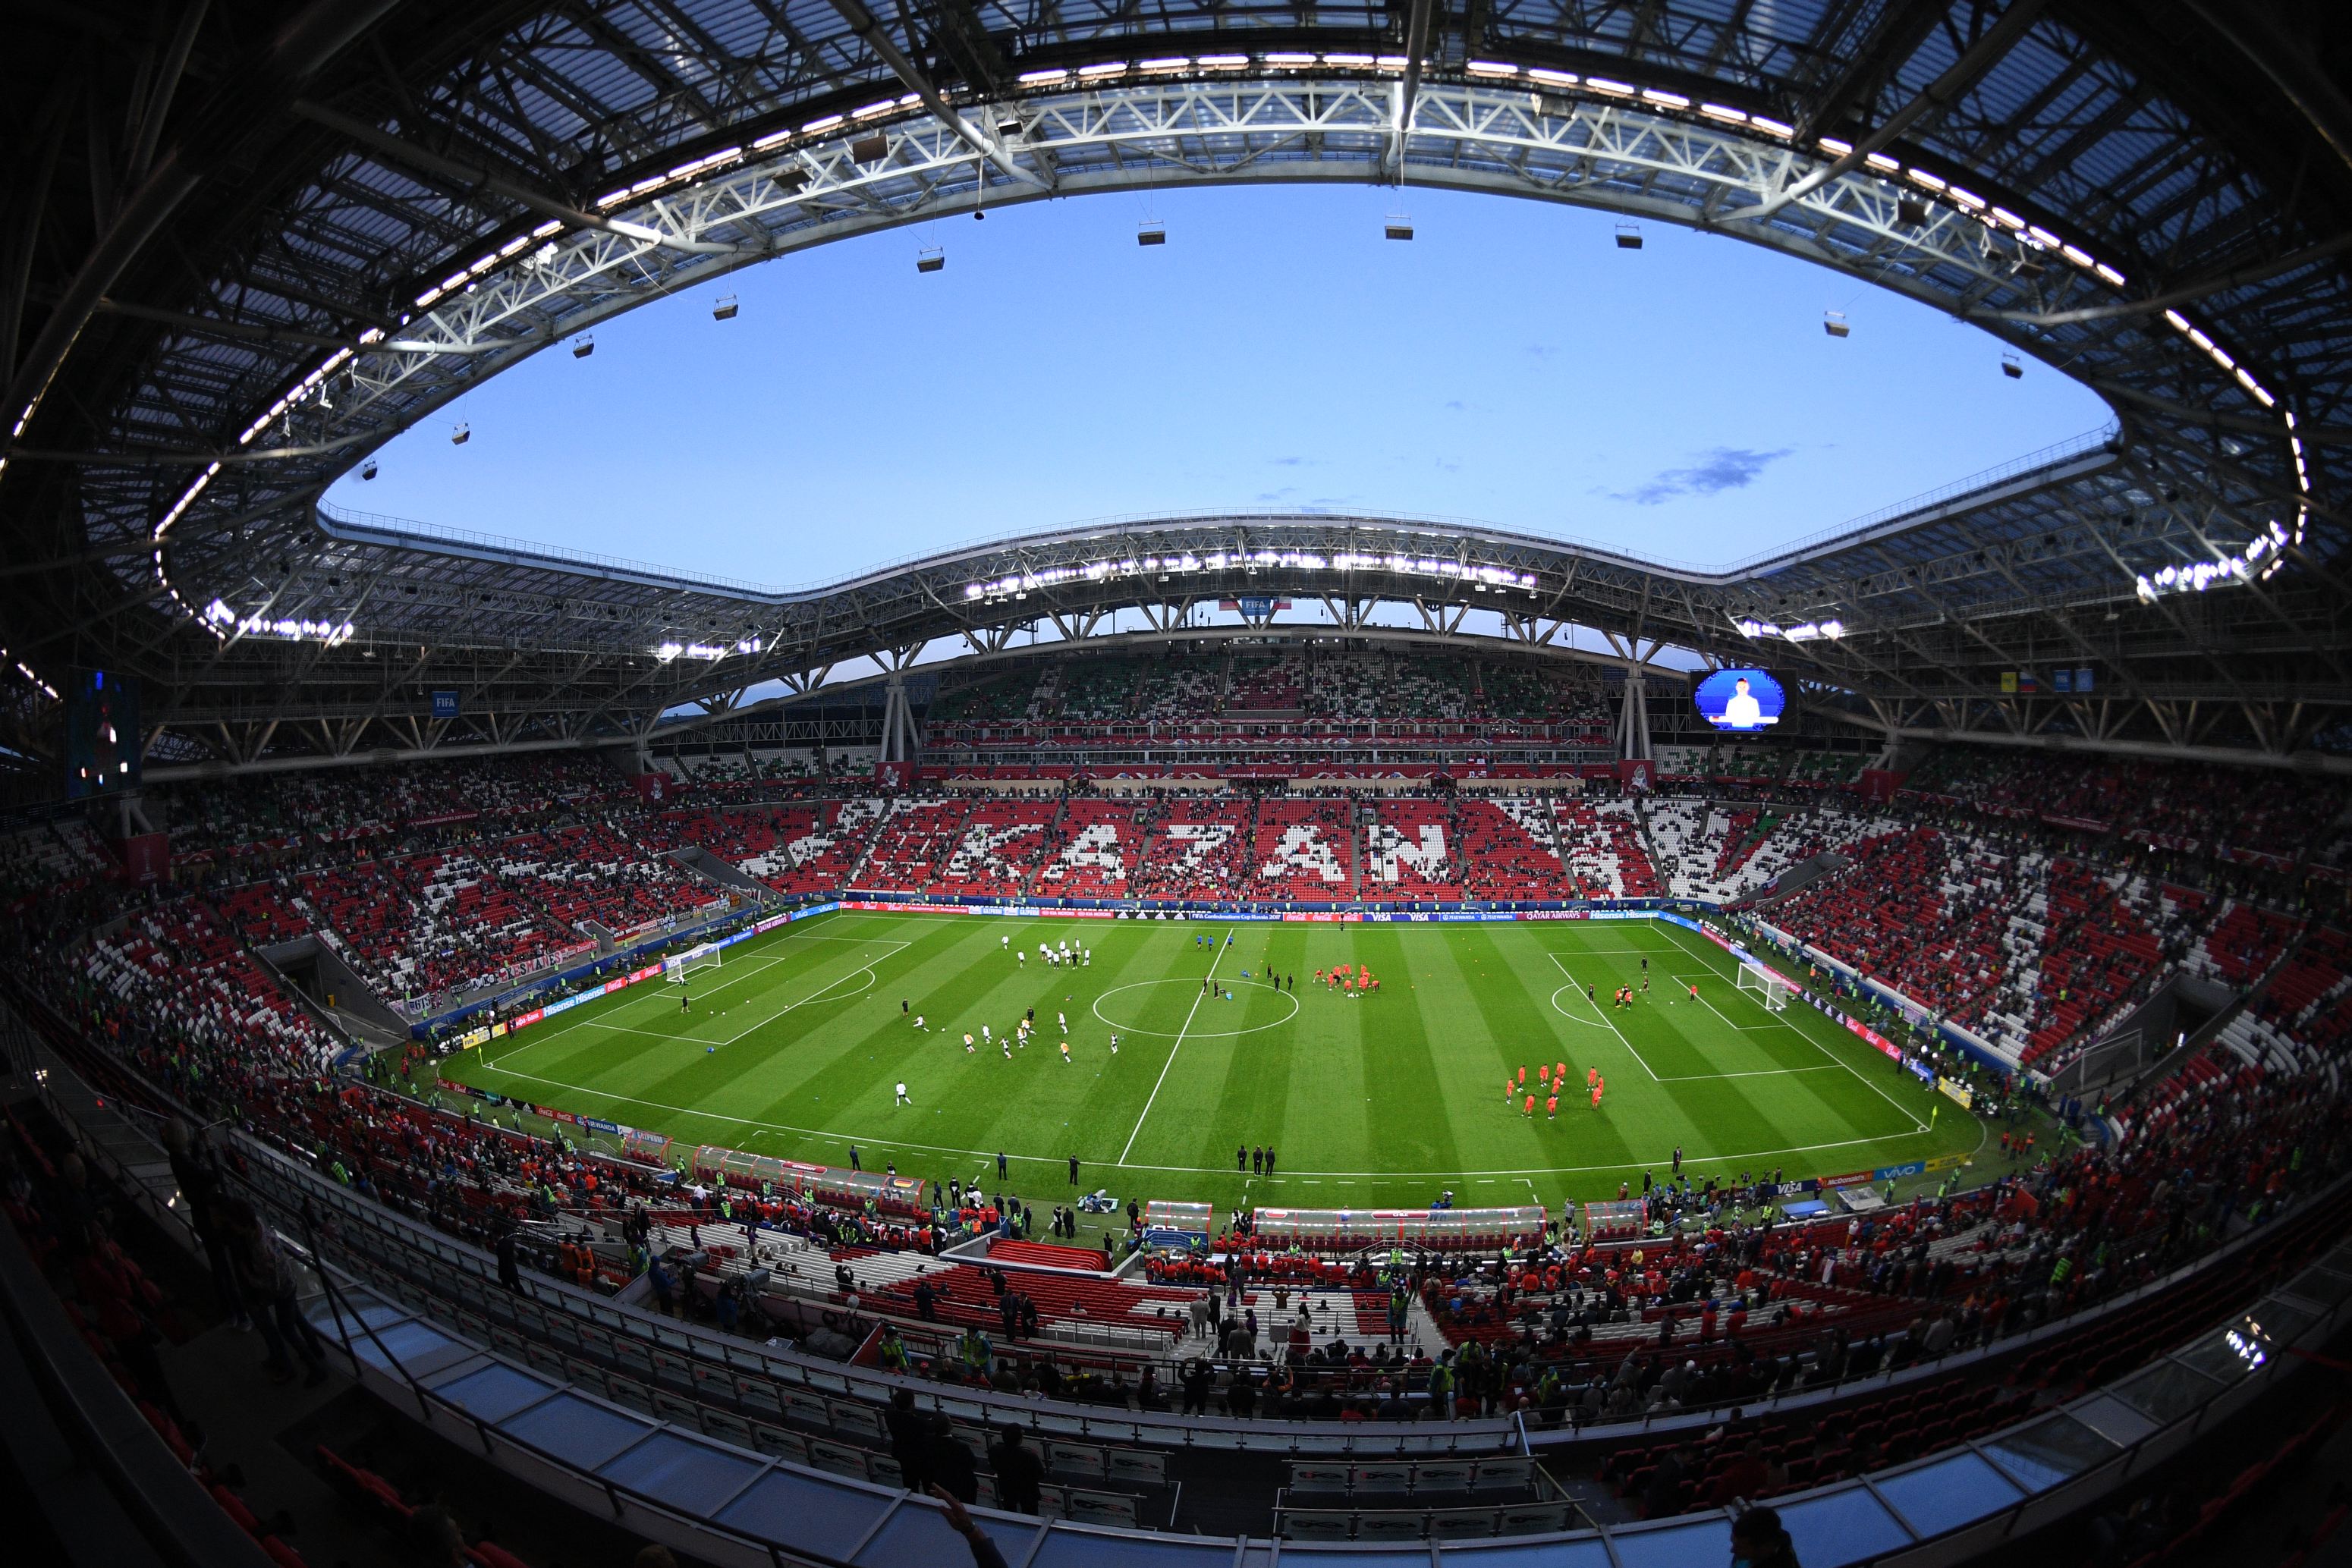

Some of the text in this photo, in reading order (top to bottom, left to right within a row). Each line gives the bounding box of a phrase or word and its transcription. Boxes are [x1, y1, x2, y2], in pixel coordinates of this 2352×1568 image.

[437, 698, 455, 707] FIFA
[945, 823, 1448, 881] KAZAN
[887, 903, 902, 911] Bud
[759, 917, 787, 933] QATAR AIRWAYS
[692, 950, 703, 959] VISA
[667, 957, 681, 969] VISA
[645, 964, 659, 977] Coca-Cola
[607, 979, 623, 991] Coca-Cola
[576, 987, 605, 1004] Hisense
[544, 998, 575, 1017] Hisense
[1845, 1016, 1858, 1032] Bud
[1865, 1029, 1879, 1045] Bud
[1886, 1043, 1901, 1061] Bud
[437, 1079, 449, 1088] Bud
[453, 1083, 467, 1094] Bud
[539, 1108, 553, 1117] Coca-Cola
[557, 1112, 572, 1122] Coca-Cola
[1827, 1174, 1865, 1186] McDonald's
[1777, 1182, 1803, 1194] VISA
